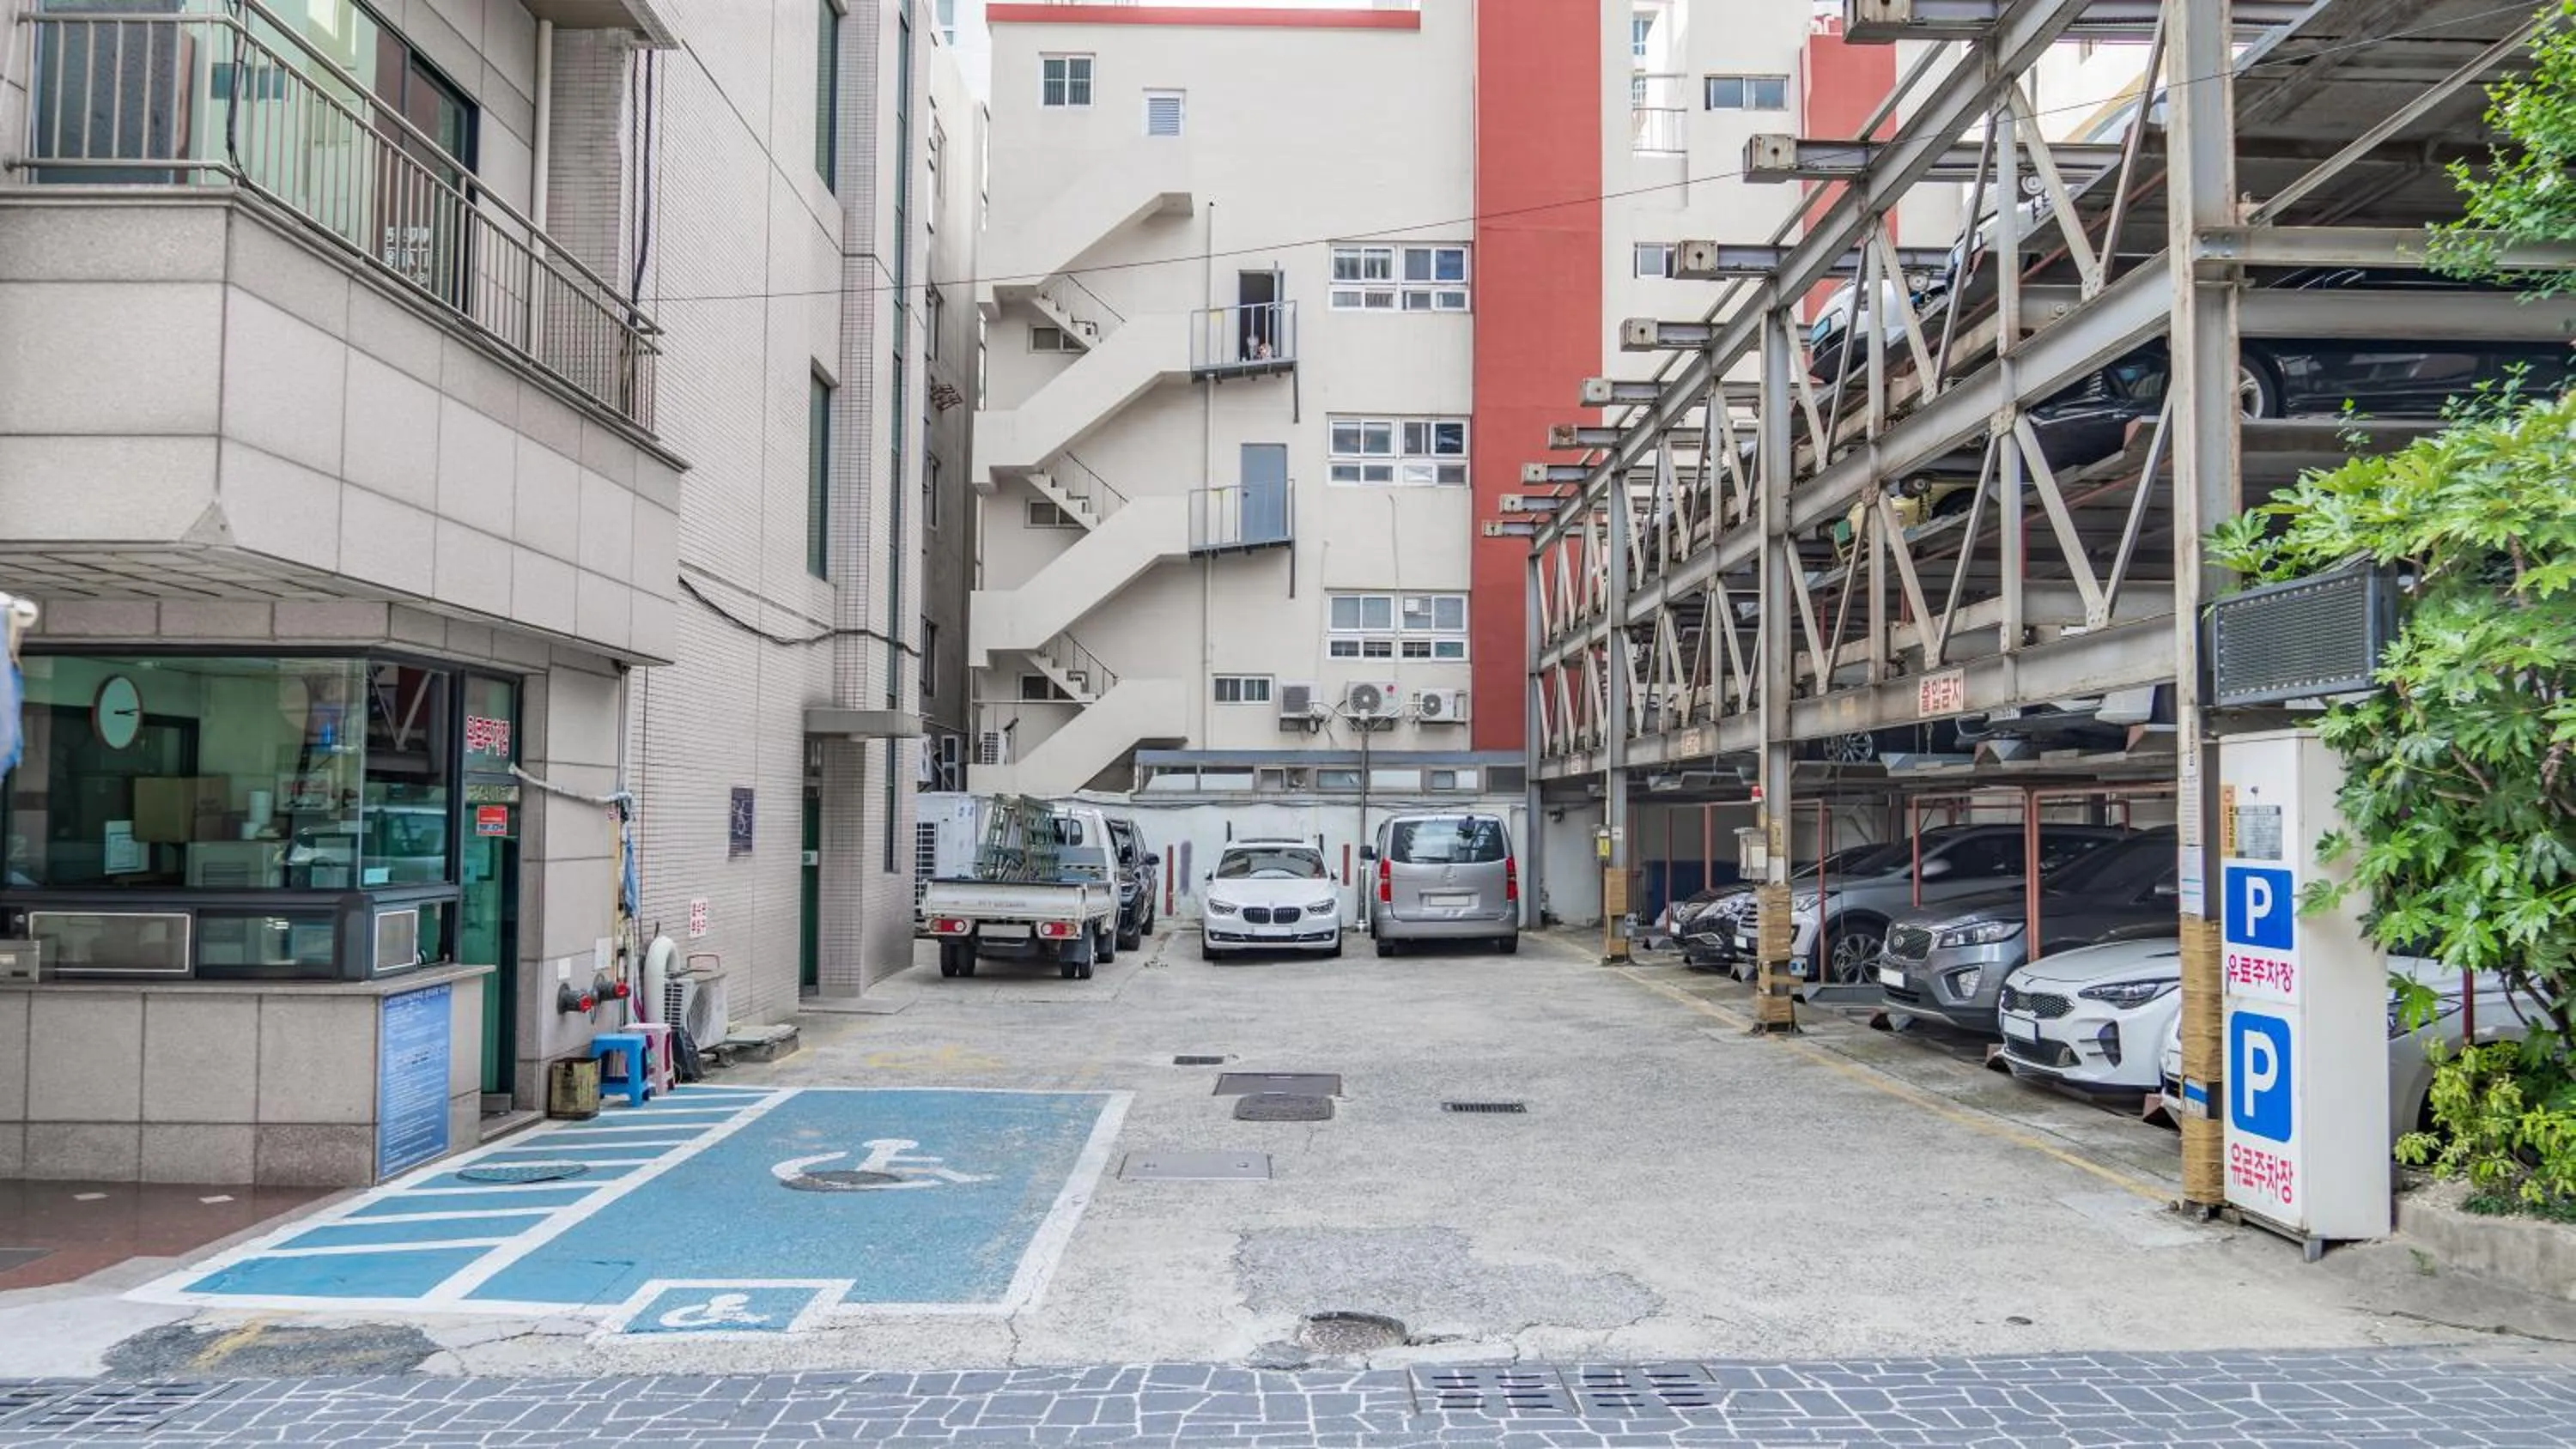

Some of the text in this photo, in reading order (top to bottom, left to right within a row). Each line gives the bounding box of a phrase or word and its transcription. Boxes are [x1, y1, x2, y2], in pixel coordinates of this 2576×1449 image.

[1922, 673, 1962, 712] 출입금지
[2245, 876, 2274, 937] P
[2229, 955, 2294, 992] 유료주차장
[2244, 1029, 2278, 1117] P
[2231, 1143, 2293, 1204] 유료주차장
